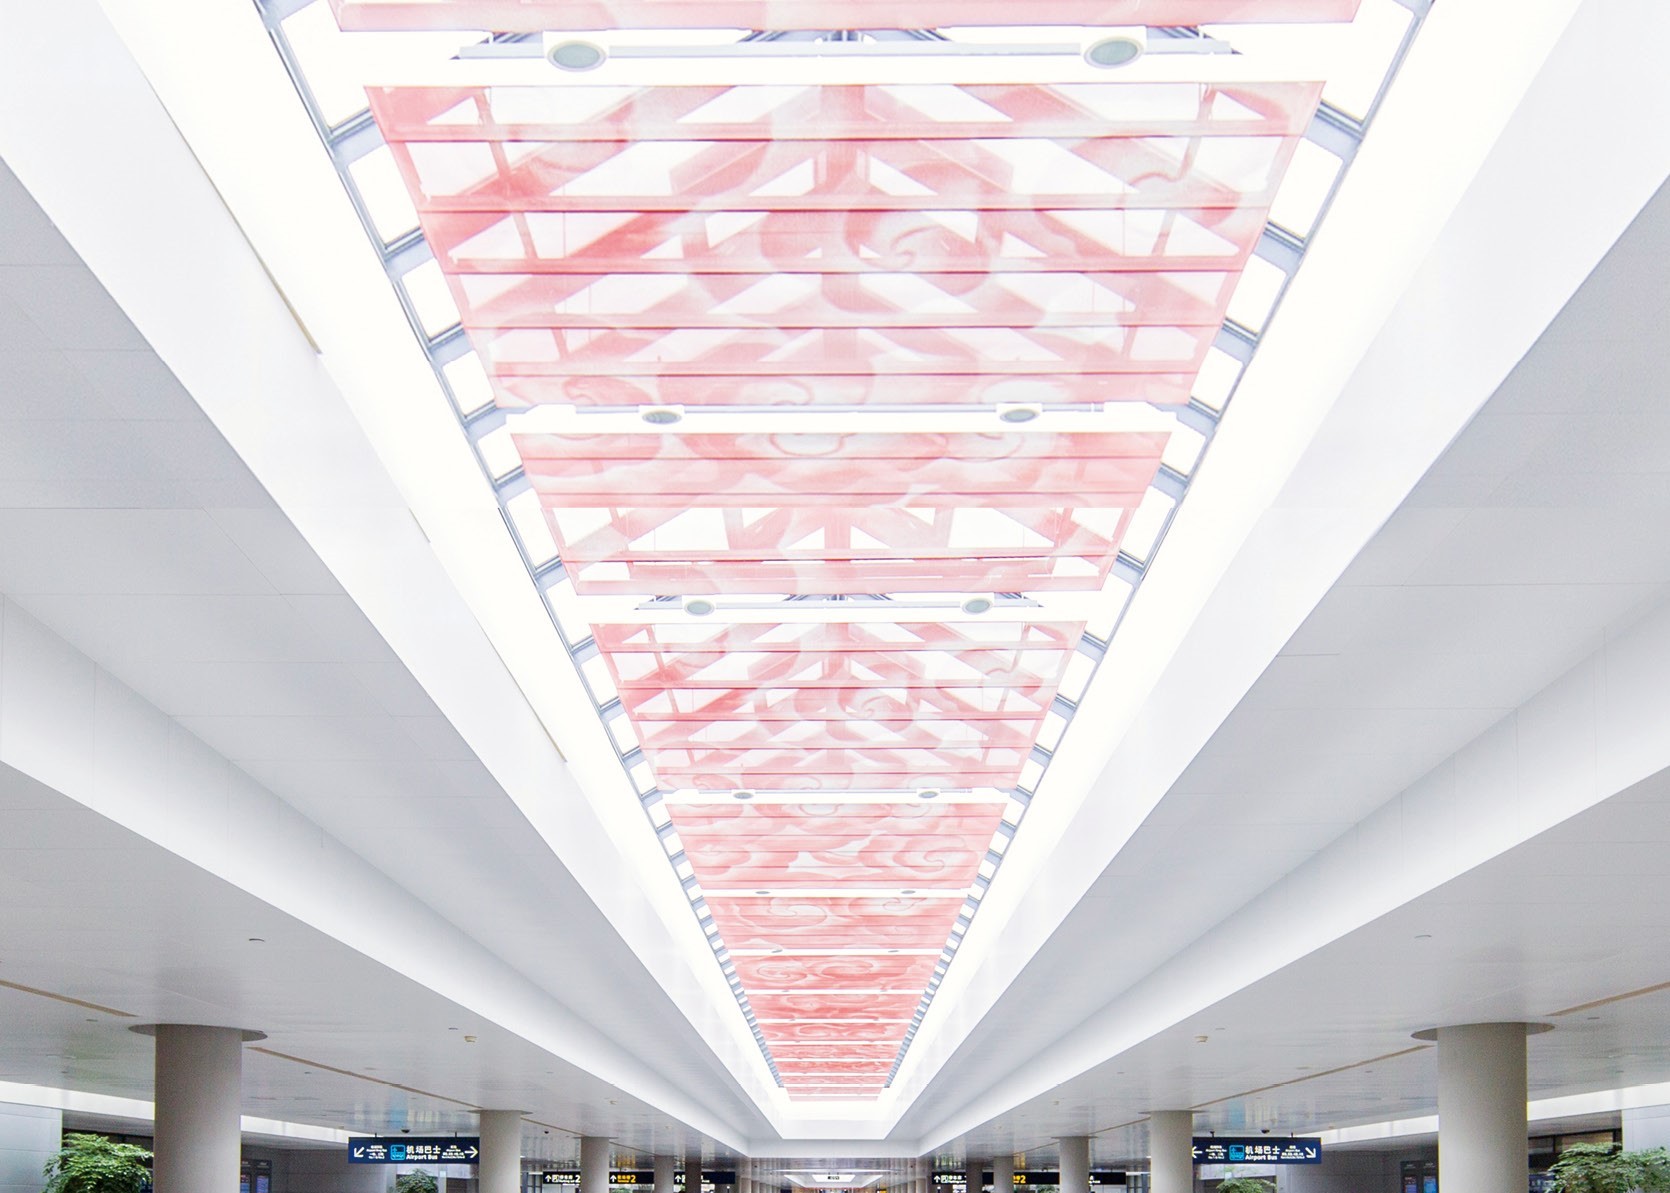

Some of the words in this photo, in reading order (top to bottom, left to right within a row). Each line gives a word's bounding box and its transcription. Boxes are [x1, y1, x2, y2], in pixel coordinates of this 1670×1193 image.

[1245, 1145, 1280, 1154] 机场巴士
[630, 1174, 637, 1183] 2
[1020, 1174, 1027, 1183] 2
